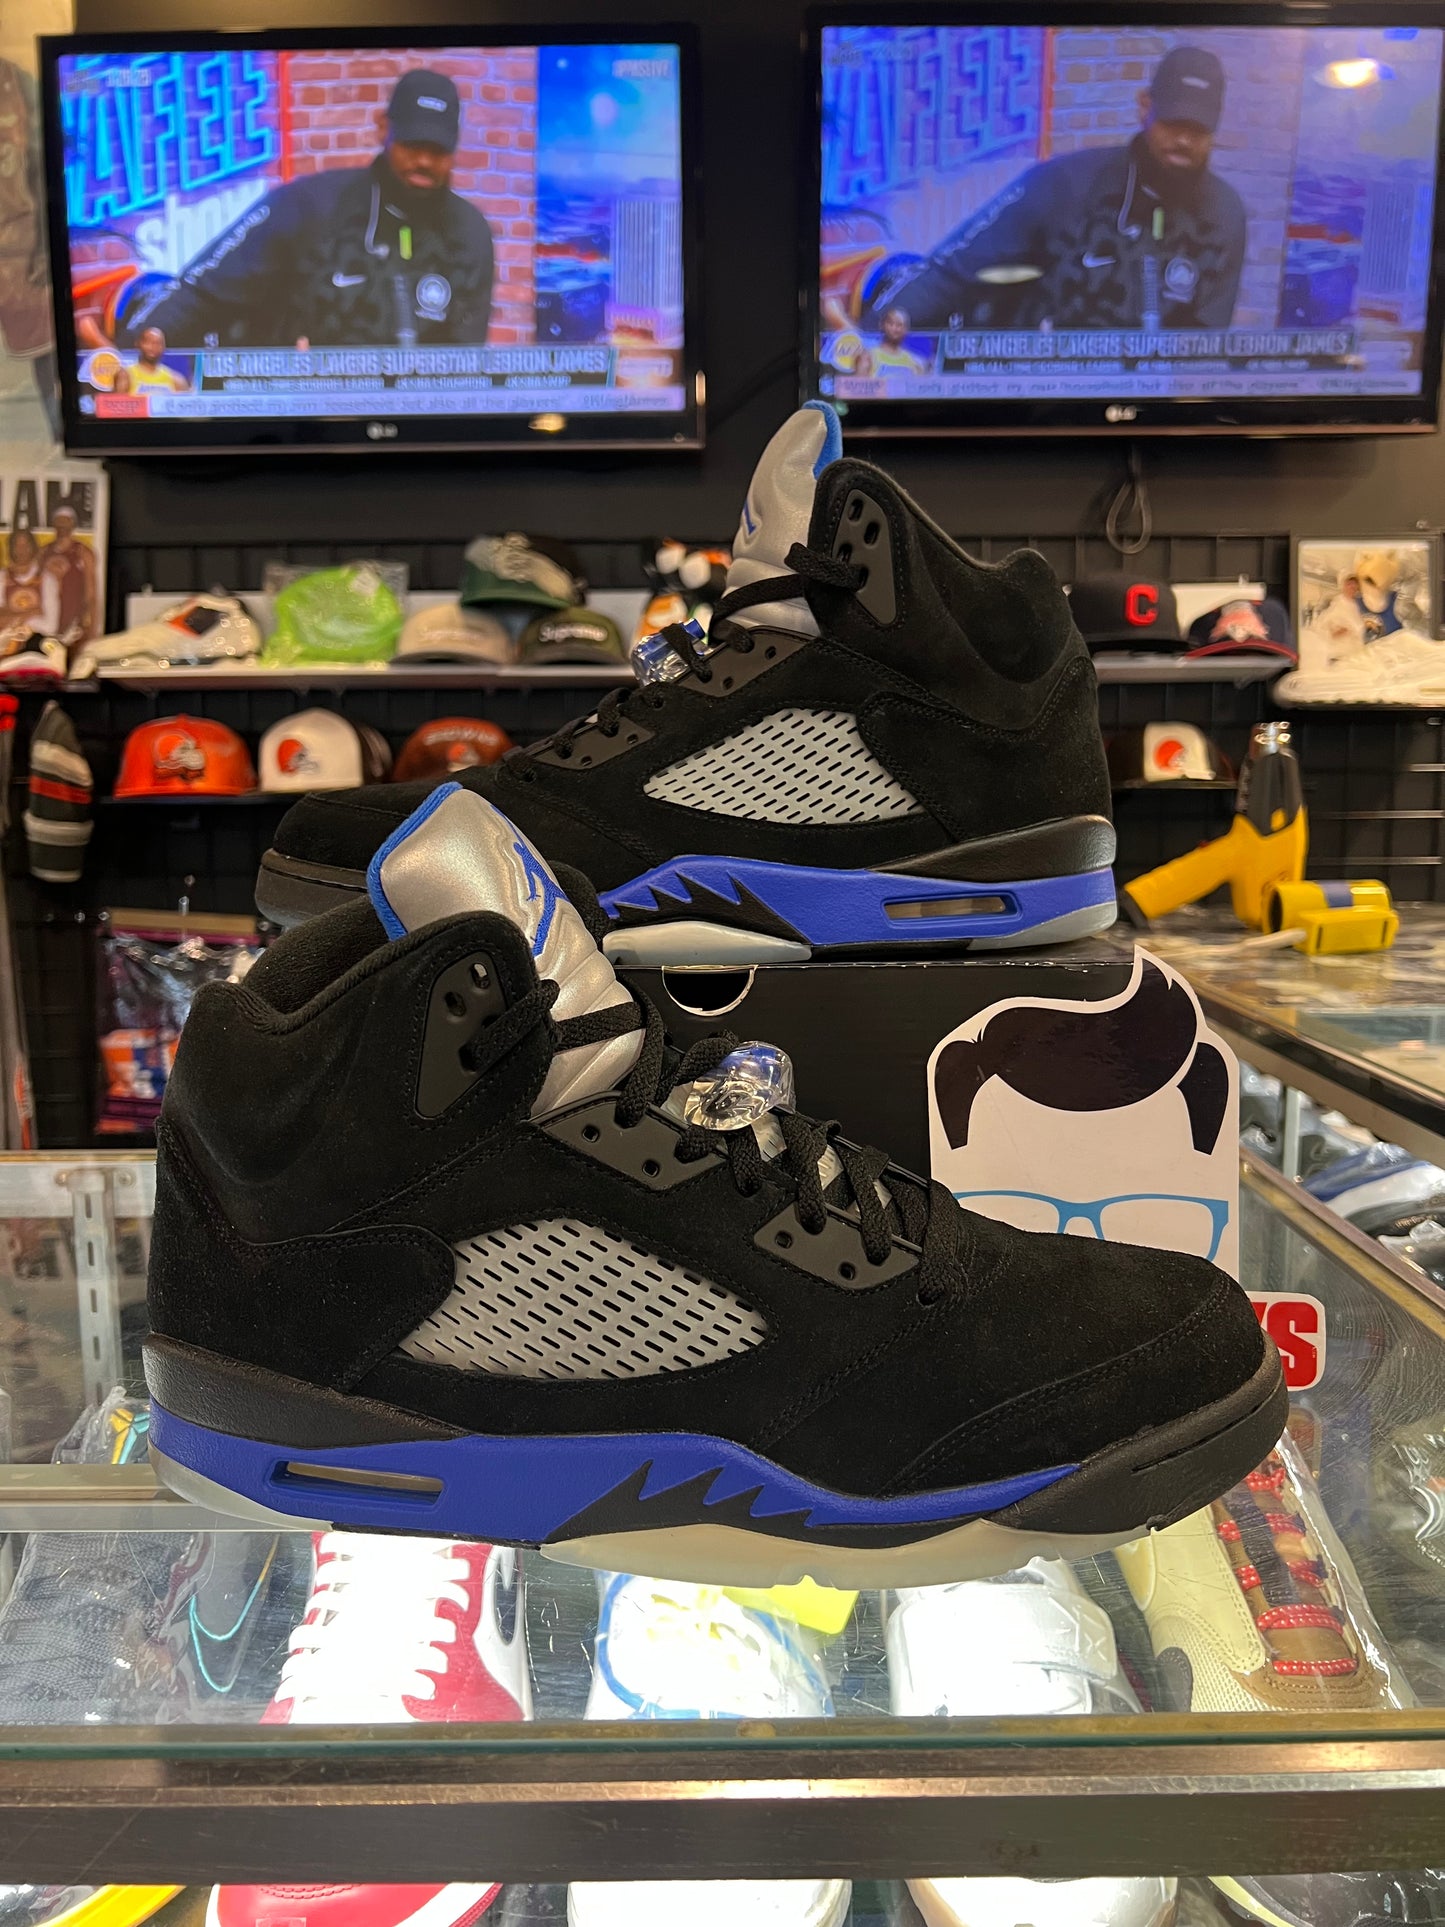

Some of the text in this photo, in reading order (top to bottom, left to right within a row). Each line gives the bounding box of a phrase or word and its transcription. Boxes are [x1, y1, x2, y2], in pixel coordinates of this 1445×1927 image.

[1057, 333, 1121, 357] LAKERS
[1292, 331, 1348, 354] JAMES
[550, 349, 605, 372] JAMES
[1125, 584, 1159, 626] C
